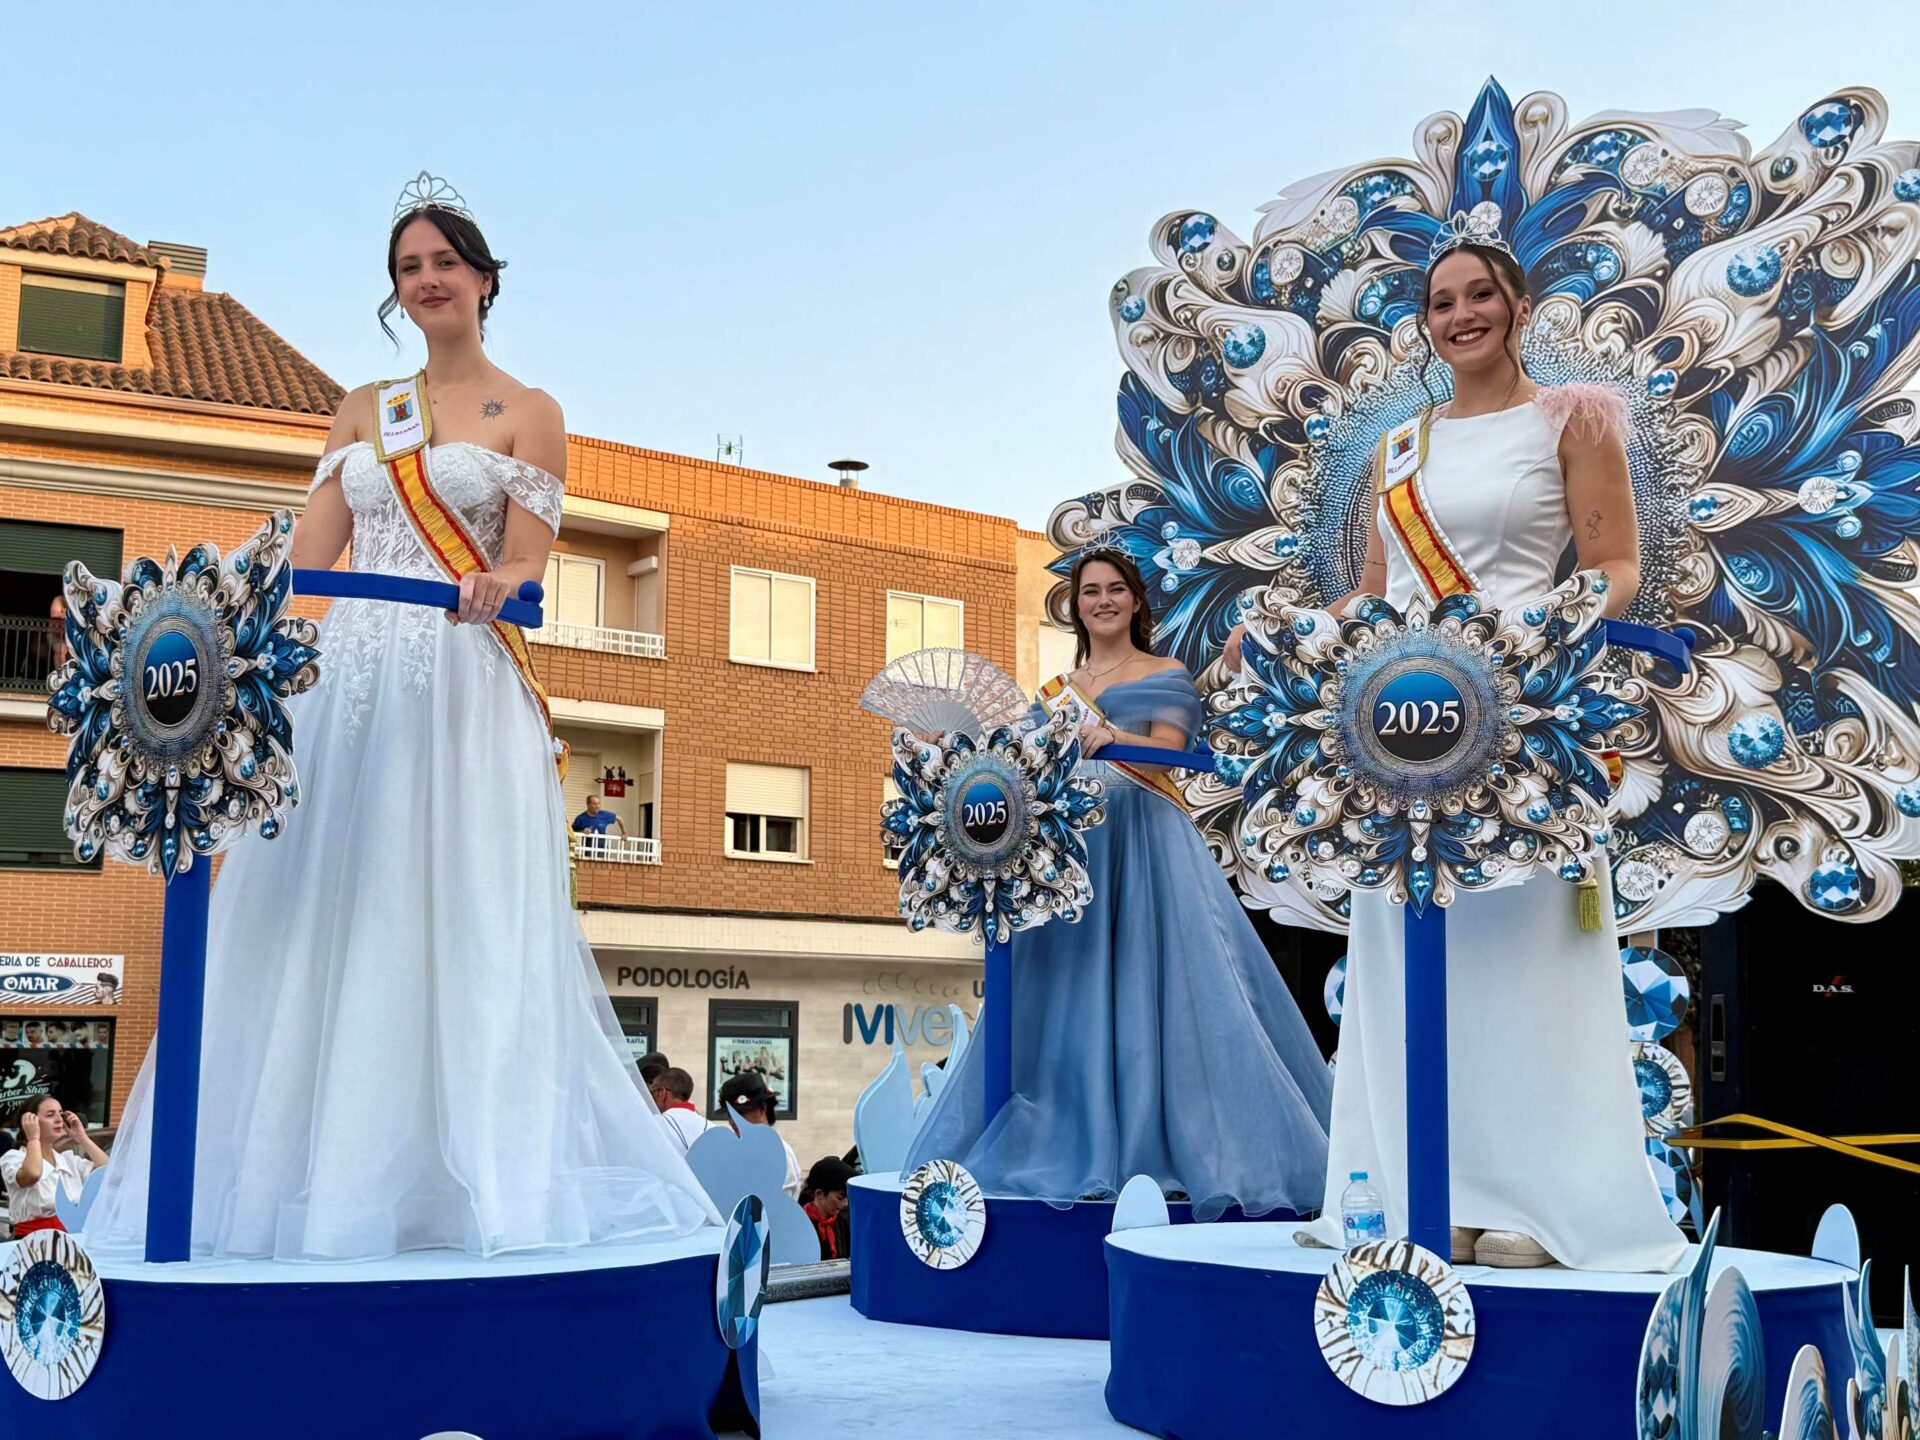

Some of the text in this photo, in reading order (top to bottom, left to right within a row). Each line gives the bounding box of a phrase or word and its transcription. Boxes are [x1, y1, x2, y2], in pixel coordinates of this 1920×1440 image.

[145, 658, 197, 701] 2025
[1379, 700, 1460, 736] 2025
[964, 800, 1007, 827] 2025
[25, 956, 41, 967] DE
[47, 956, 113, 969] CABALLEROS
[3, 975, 60, 991] OMAR
[617, 965, 750, 989] PODOLOGÍA
[25, 1084, 49, 1097] Shop
